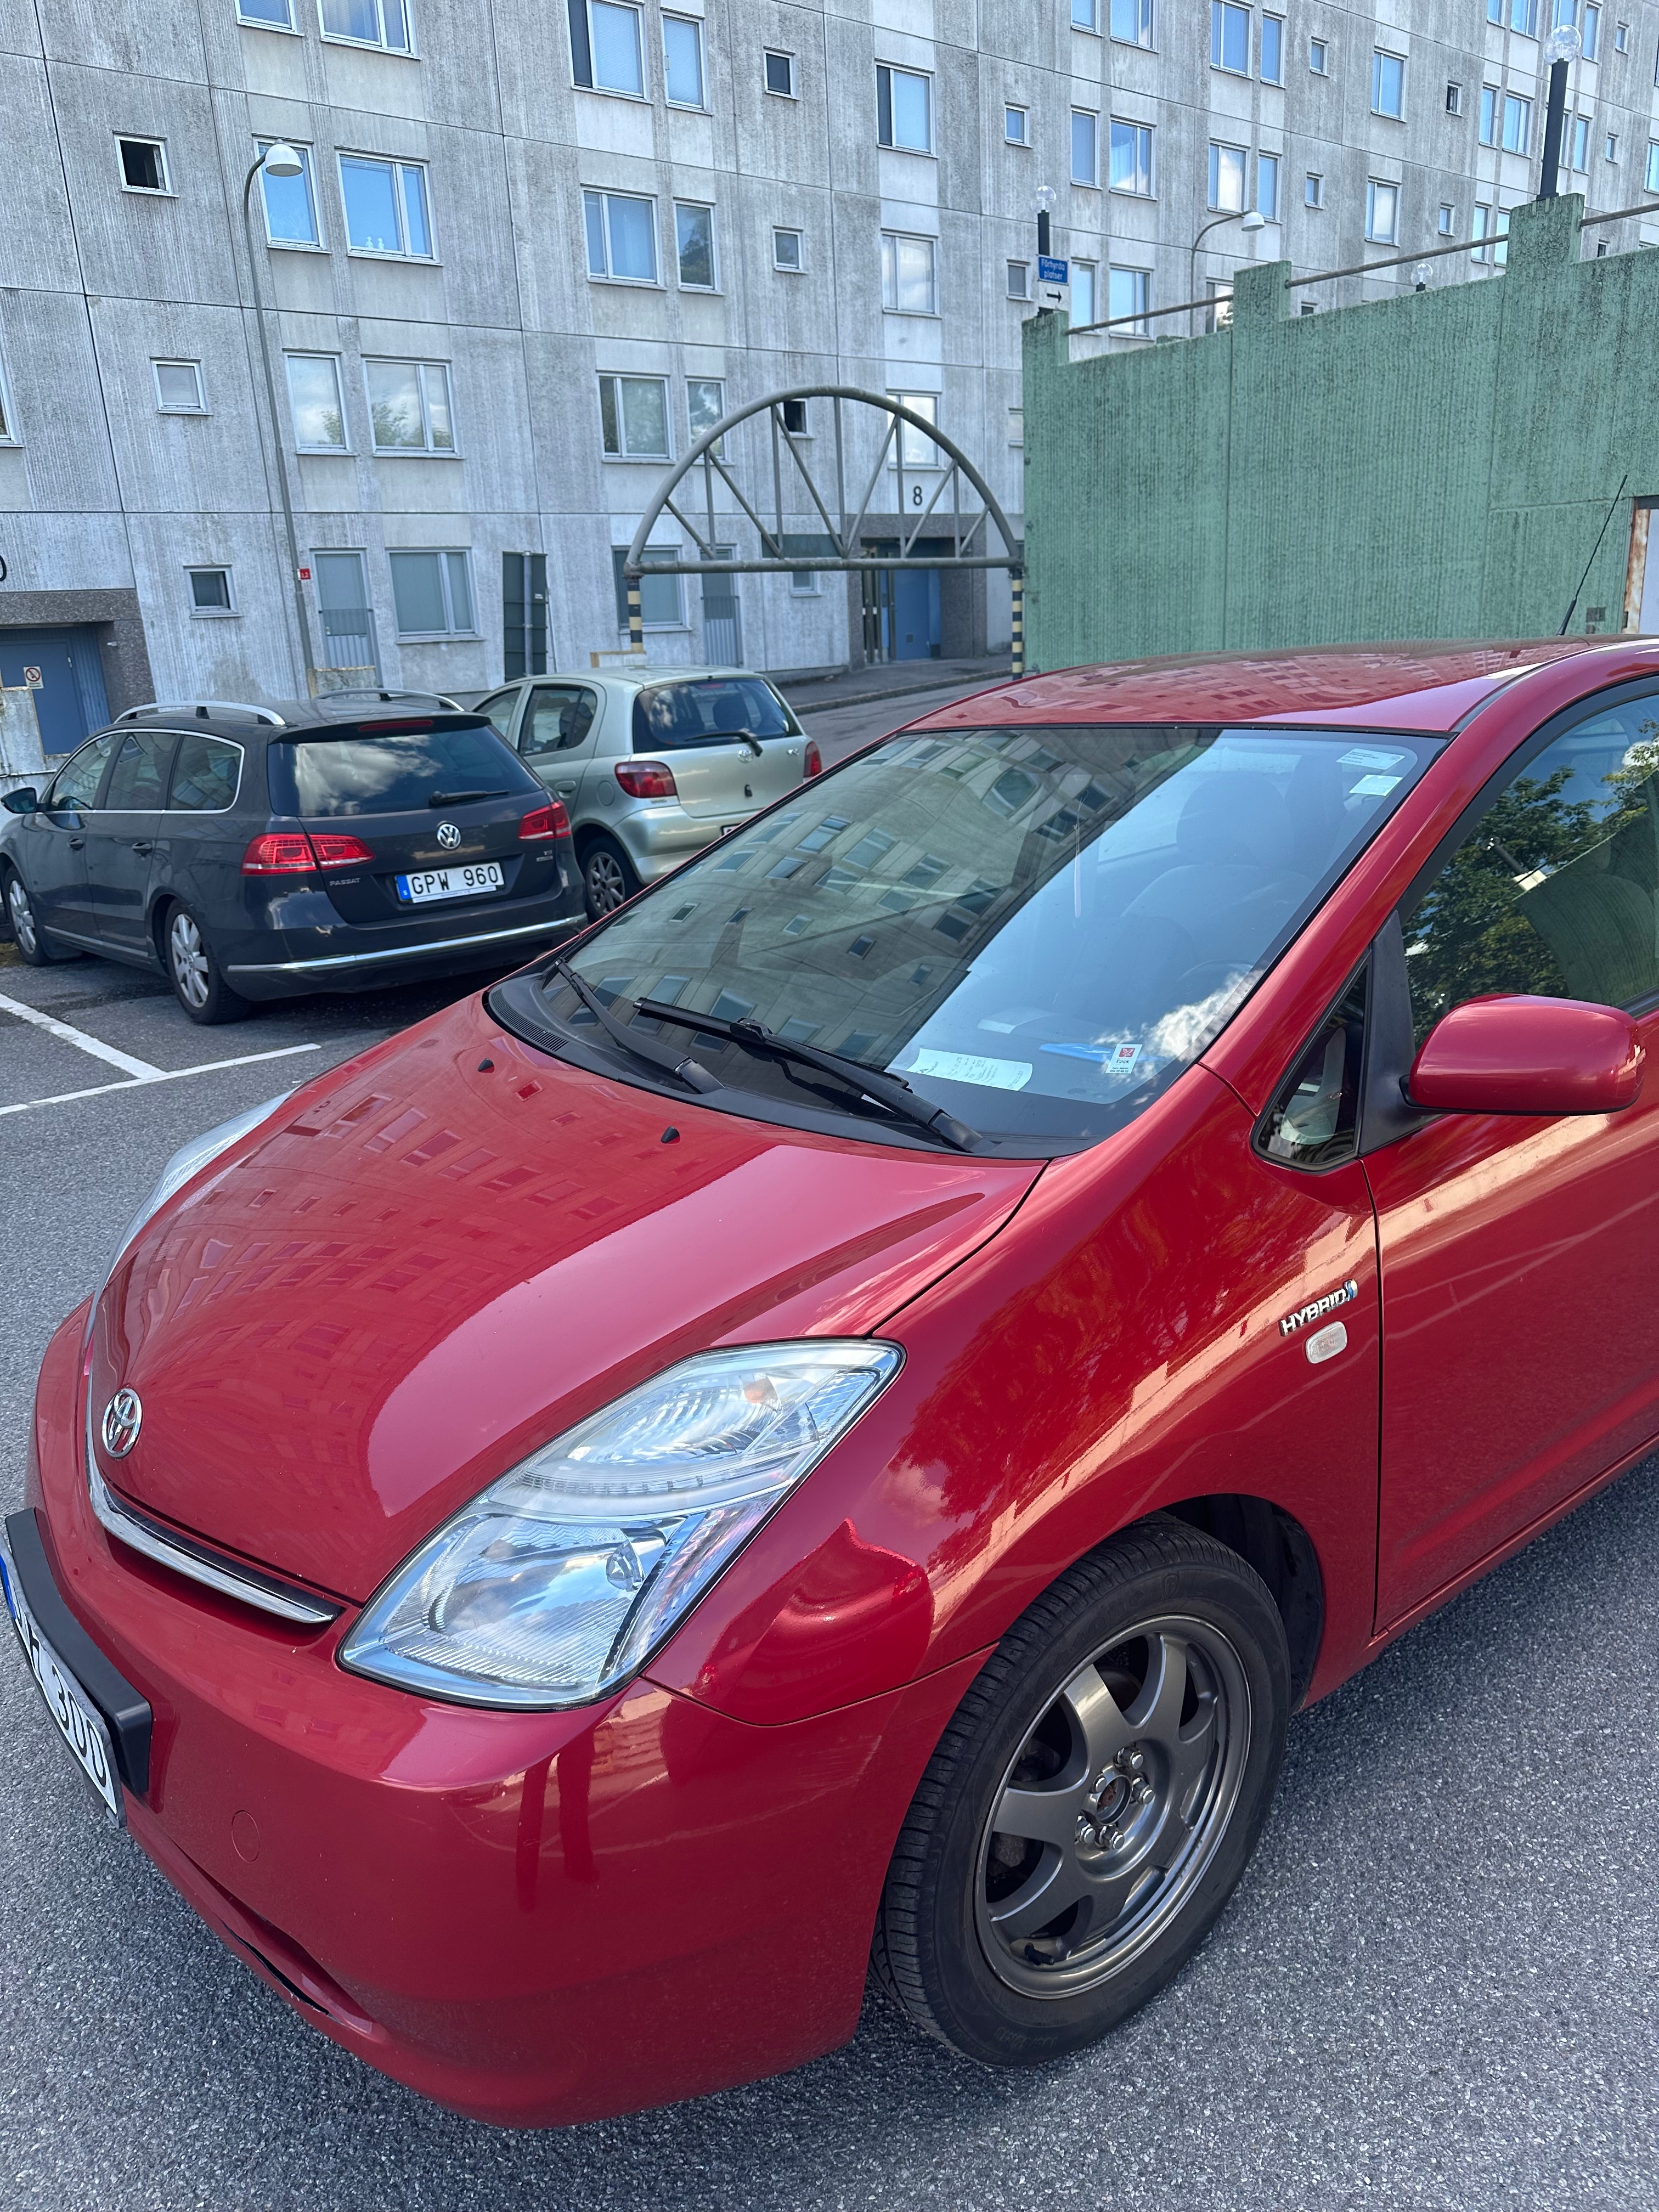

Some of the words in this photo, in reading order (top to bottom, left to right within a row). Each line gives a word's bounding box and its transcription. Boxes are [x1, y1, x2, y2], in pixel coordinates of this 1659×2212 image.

[1044, 270, 1063, 280] platser
[913, 486, 922, 506] 8
[330, 878, 360, 886] PASSAT
[411, 872, 450, 894] GPW
[464, 866, 498, 887] 960
[1279, 1288, 1347, 1336] HYBRID
[52, 1664, 106, 1787] 300
